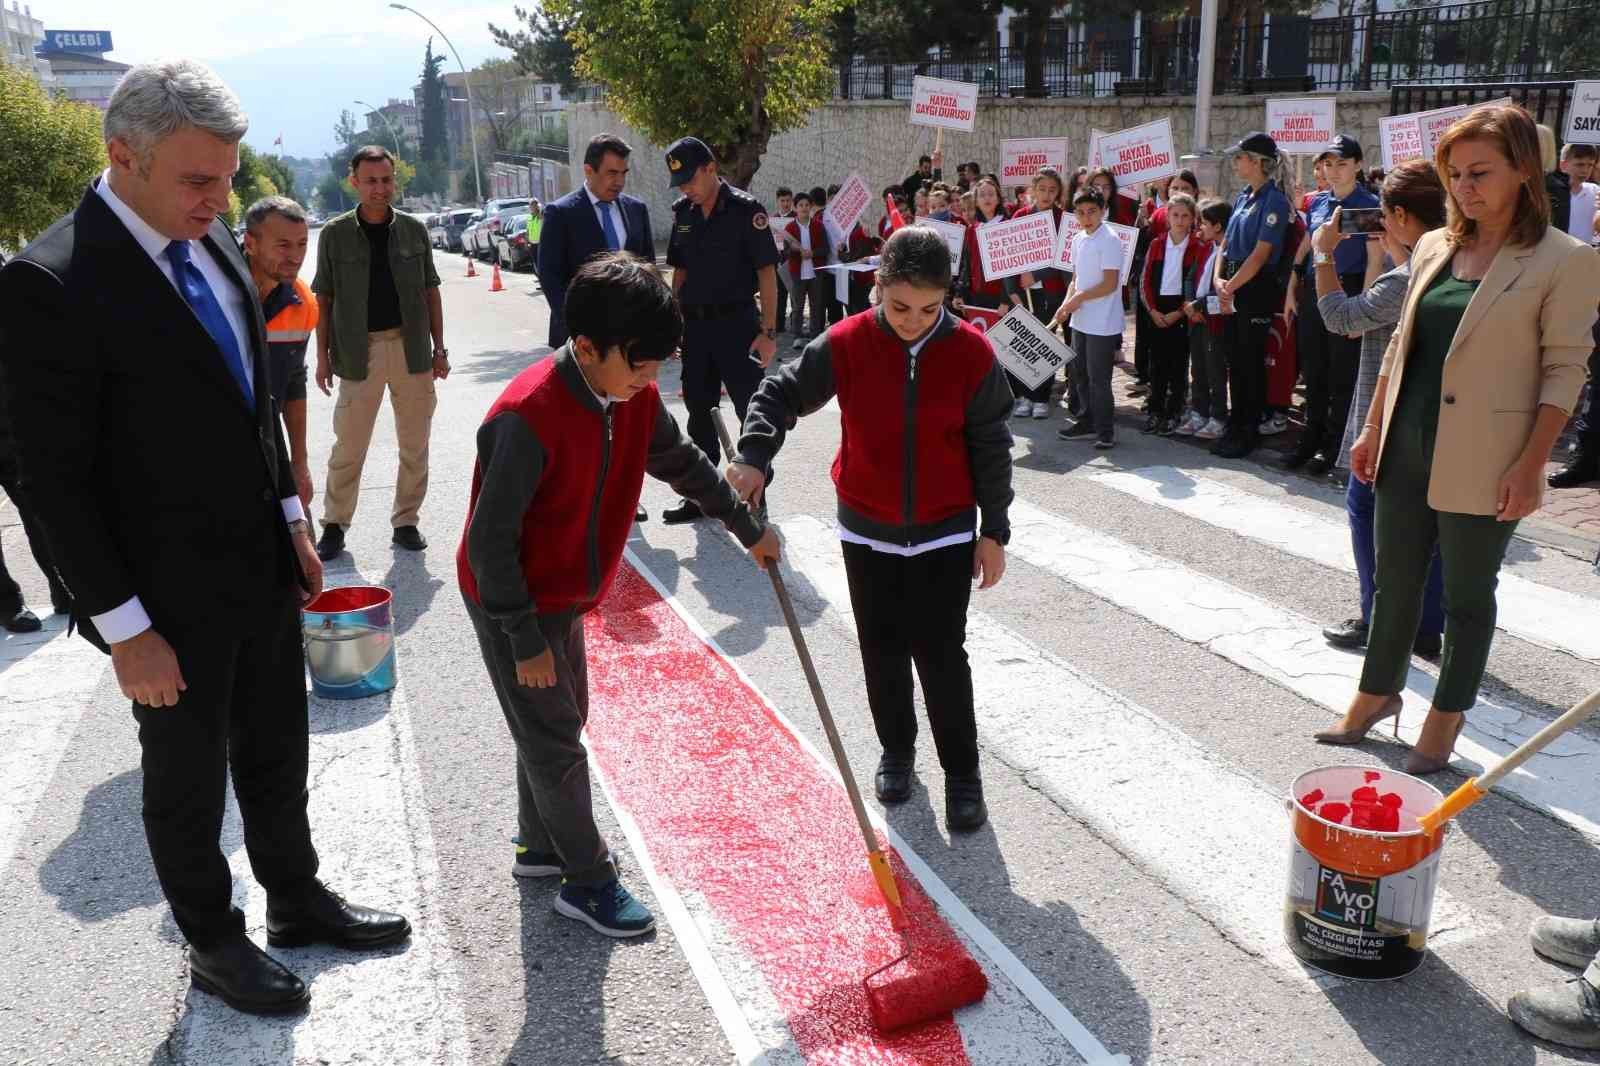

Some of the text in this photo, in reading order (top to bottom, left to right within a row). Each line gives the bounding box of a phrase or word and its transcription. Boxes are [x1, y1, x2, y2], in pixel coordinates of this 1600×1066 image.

[55, 32, 102, 48] ÇELEBİ
[929, 95, 958, 107] HAYATA
[916, 103, 938, 116] SAYGI
[1283, 117, 1314, 129] HAYATA
[1270, 129, 1294, 143] SAYGI
[1390, 132, 1404, 142] 29
[1119, 143, 1152, 162] HAYATA
[1018, 154, 1047, 166] HAYATA
[1004, 164, 1028, 177] SAYGI
[1109, 160, 1132, 177] AYGI
[988, 240, 1000, 250] 29
[1008, 335, 1041, 365] HAYATA
[1036, 342, 1063, 367] SAYGI
[1304, 919, 1321, 935] YOL
[1346, 936, 1385, 948] BOYASI
